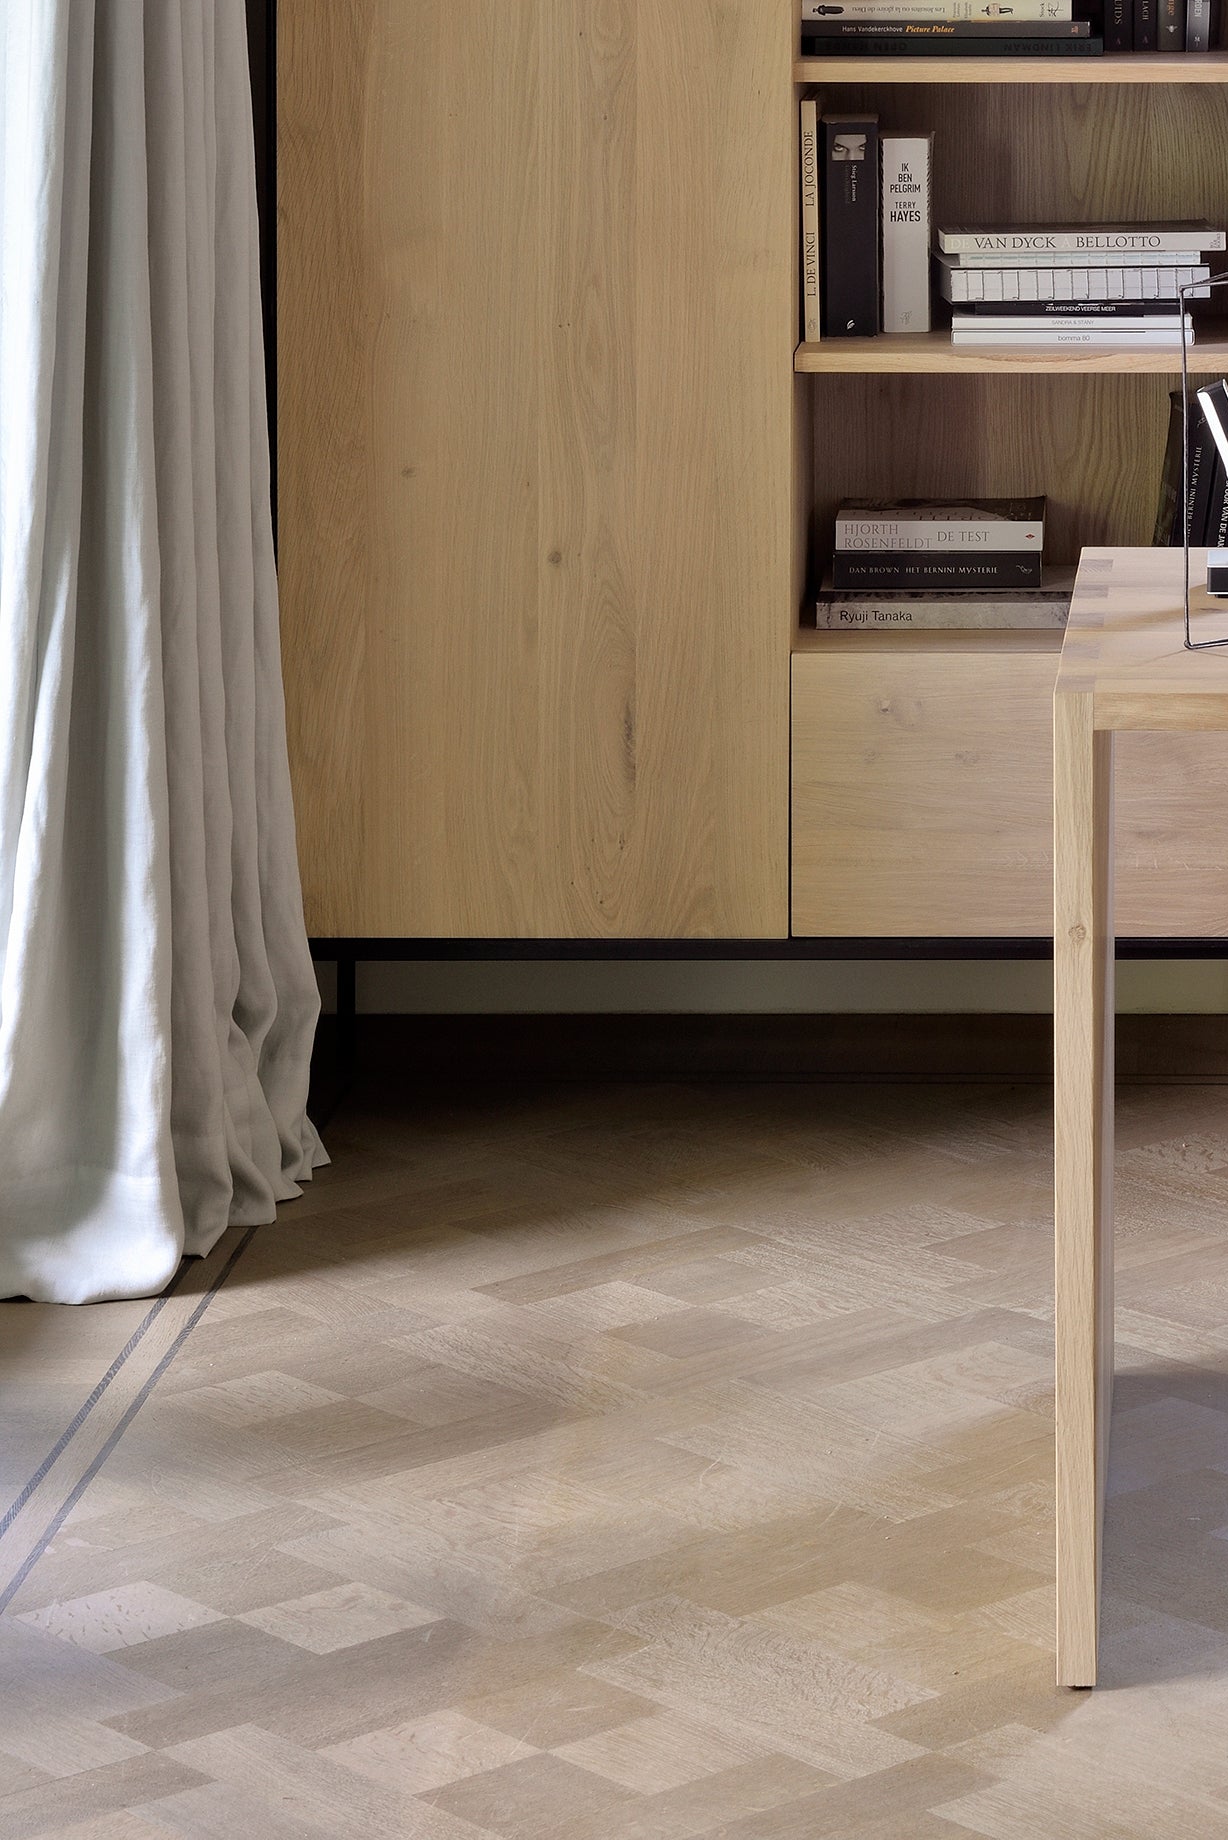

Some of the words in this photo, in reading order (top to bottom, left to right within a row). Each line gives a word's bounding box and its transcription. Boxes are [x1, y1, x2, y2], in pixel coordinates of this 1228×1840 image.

[852, 6, 867, 14] Dieu
[868, 6, 875, 14] de
[935, 6, 946, 14] Les
[858, 25, 903, 33] Vandekerckhove
[905, 25, 931, 33] Picture
[932, 25, 955, 33] Palace
[804, 131, 816, 190] JOCONDE
[850, 164, 858, 179] Stieg
[902, 163, 909, 172] IK
[898, 173, 912, 182] BEN
[890, 184, 921, 193] PELGRIM
[805, 192, 814, 207] LA
[890, 211, 921, 222] HAYES
[951, 238, 970, 248] DE
[974, 236, 1008, 248] VAN
[1011, 236, 1056, 248] DYCK
[1075, 236, 1161, 248] BELLOTTO
[806, 232, 816, 268] VINCI
[806, 269, 816, 285] DE
[807, 288, 816, 297] L.
[1192, 446, 1202, 486] MYSTERIE
[1188, 488, 1197, 521] BERNINI
[844, 524, 899, 536] HJORTH
[1219, 522, 1228, 534] DE
[937, 531, 954, 542] DE
[960, 531, 990, 542] TEST
[844, 537, 933, 549] ROSENFELDT
[849, 566, 866, 574] DAN
[869, 566, 900, 574] BROWN
[905, 566, 920, 574] HET
[923, 566, 956, 574] BERNINI
[958, 566, 998, 574] MYSTERIE
[840, 610, 869, 624] Ryuji
[872, 610, 912, 621] Tanaka
